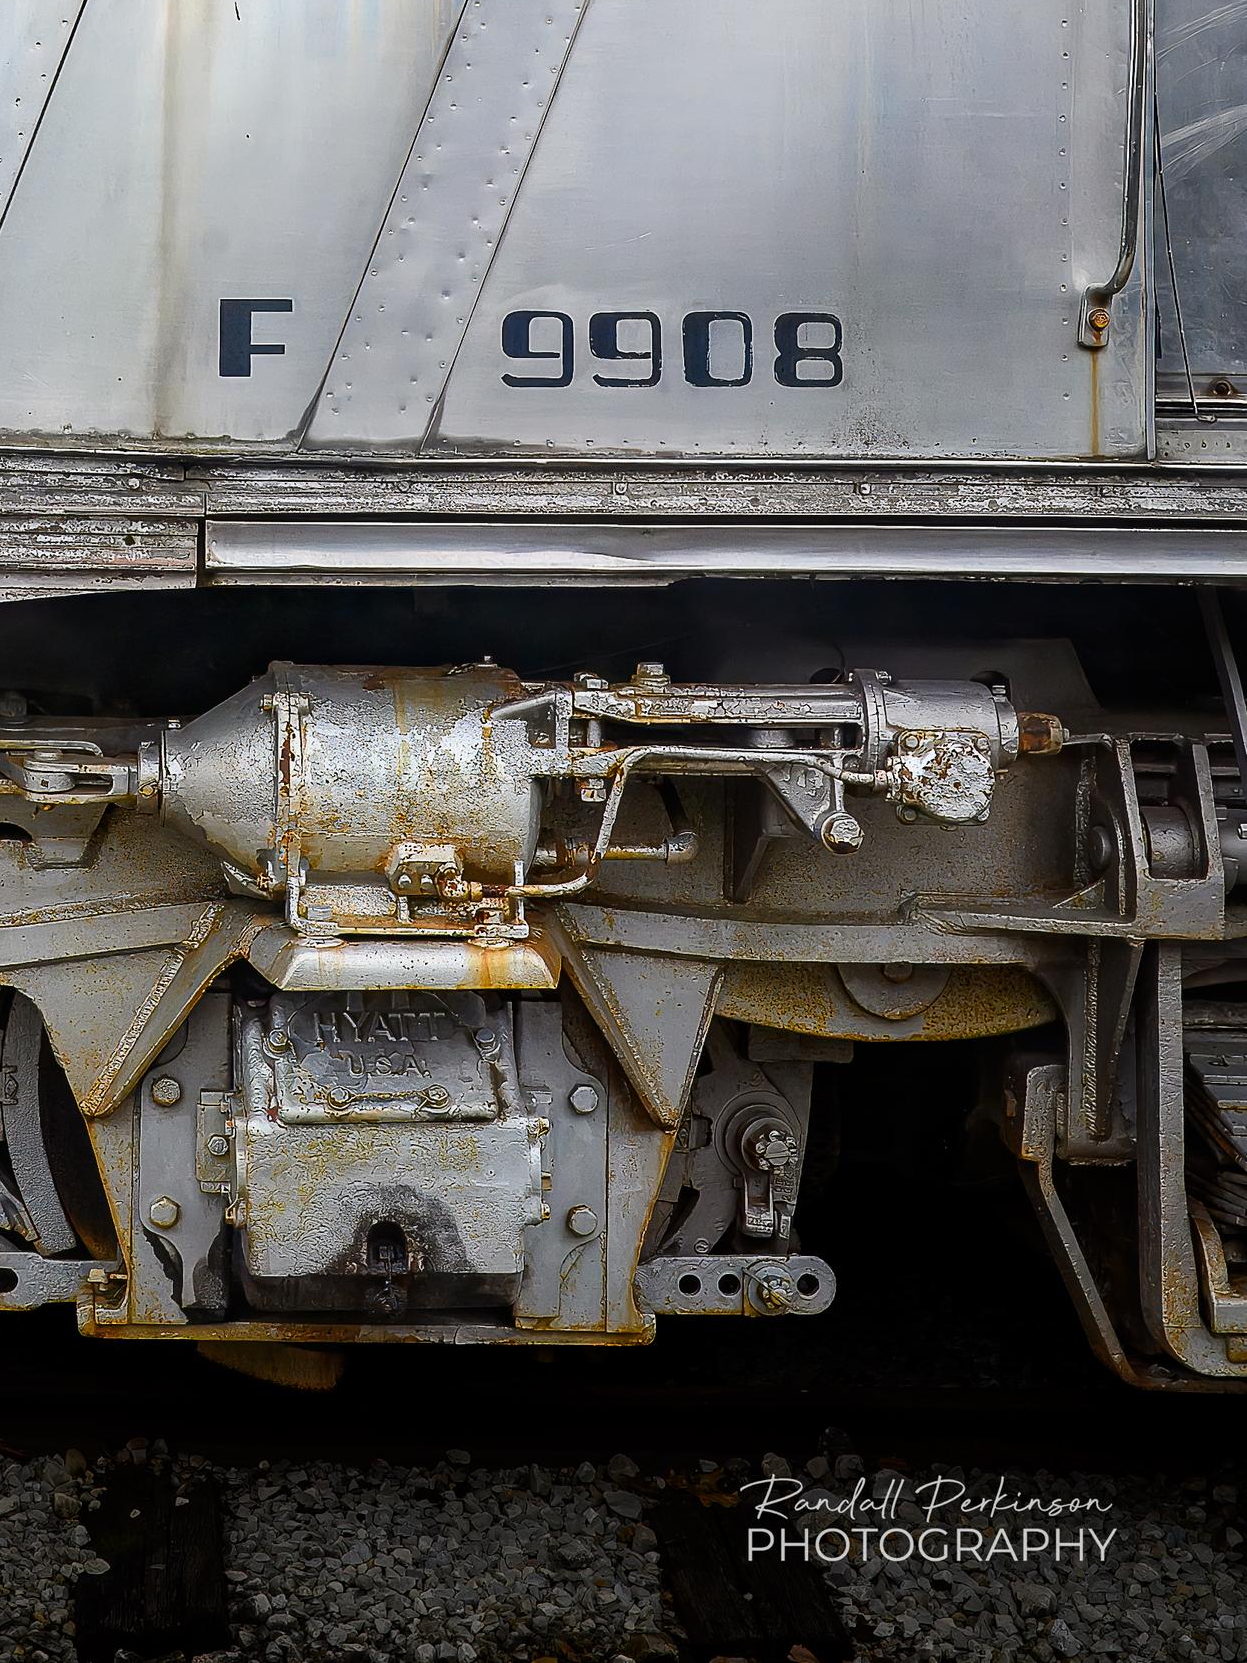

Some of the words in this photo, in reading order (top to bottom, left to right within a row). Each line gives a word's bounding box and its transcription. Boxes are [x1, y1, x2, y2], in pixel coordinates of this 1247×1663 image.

[220, 299, 293, 377] F
[501, 310, 844, 388] 9908
[313, 1012, 446, 1042] HYATT
